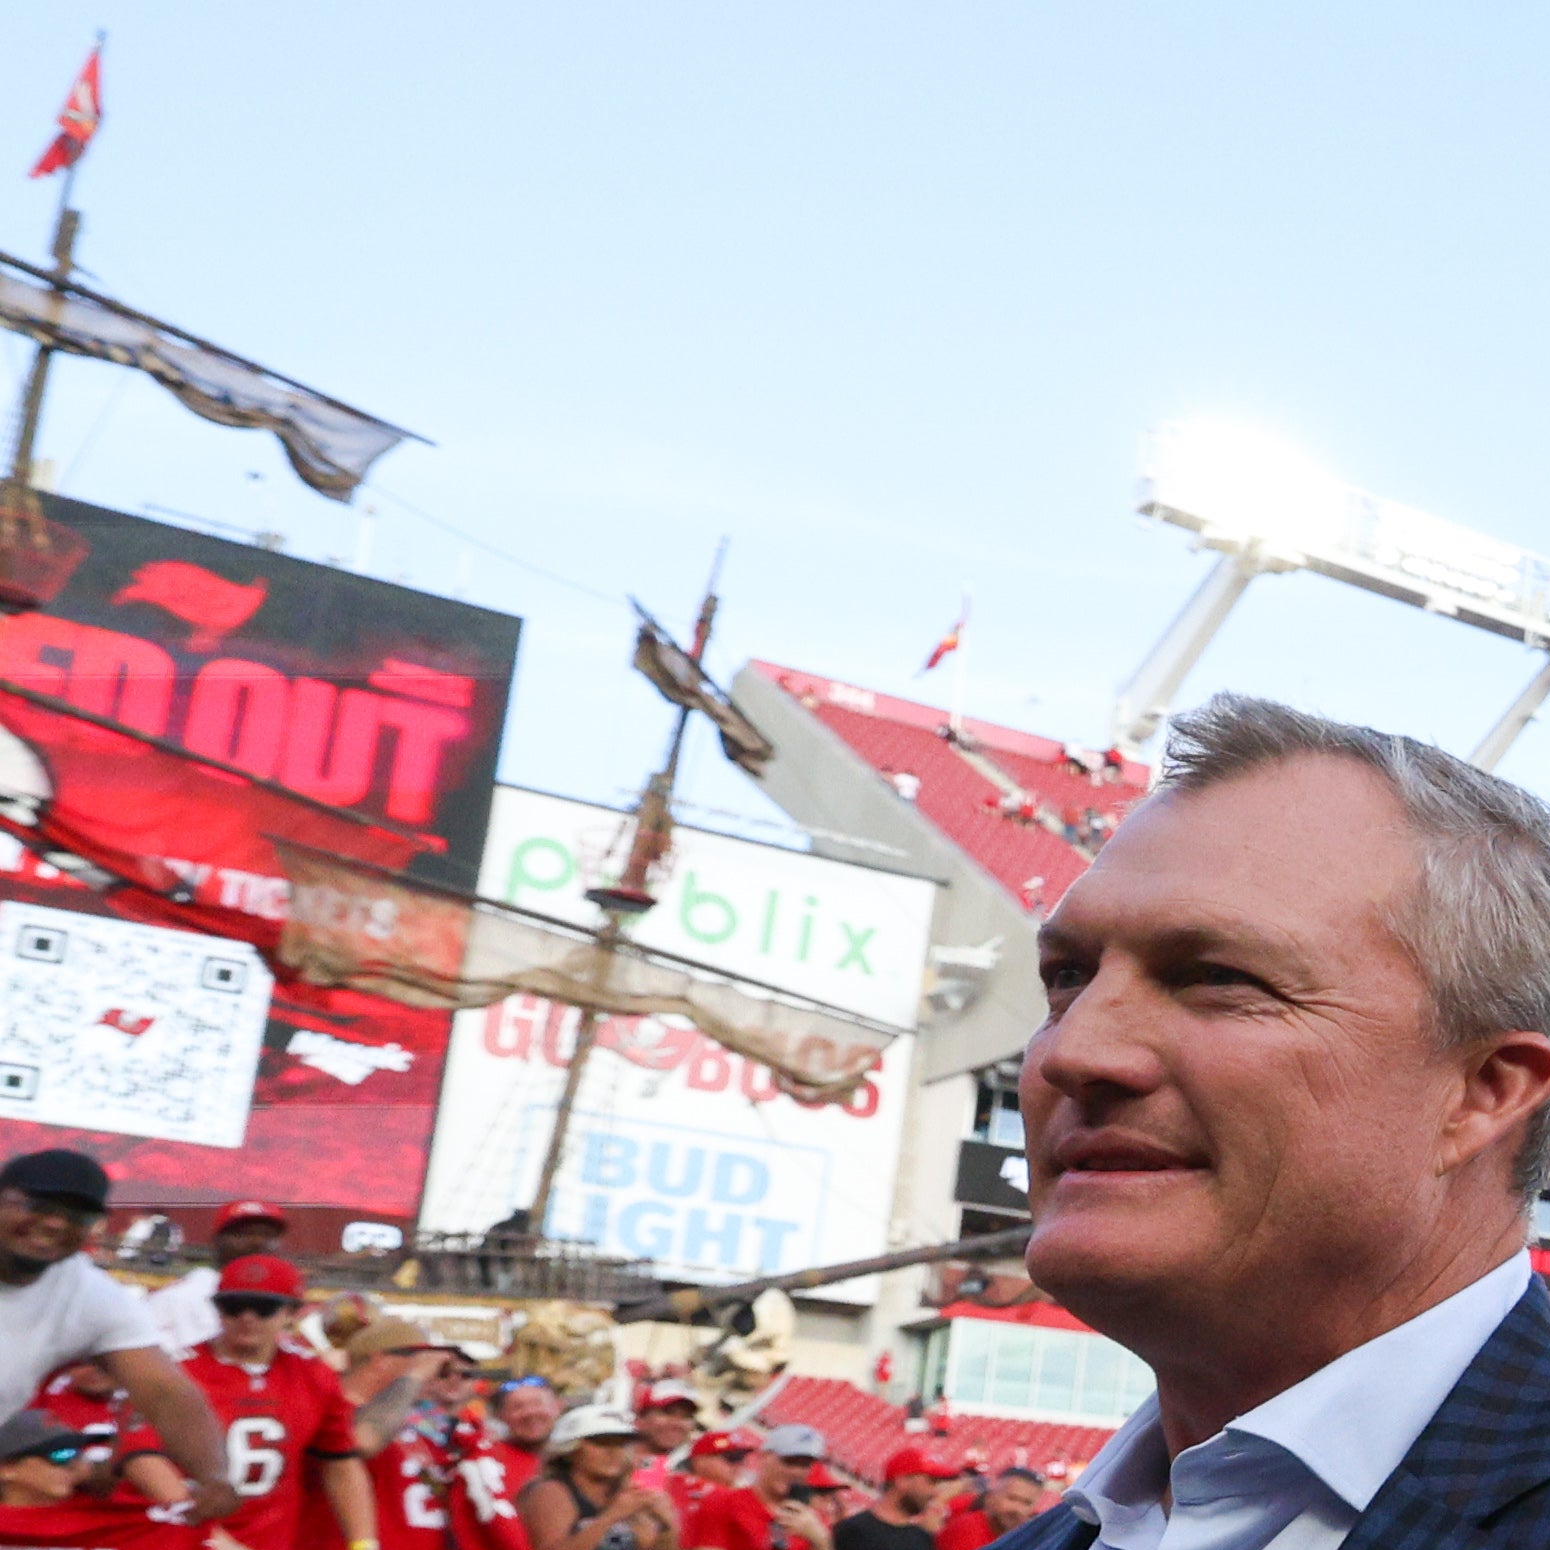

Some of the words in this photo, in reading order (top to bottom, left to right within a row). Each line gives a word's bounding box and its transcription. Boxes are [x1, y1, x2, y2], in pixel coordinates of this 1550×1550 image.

[184, 656, 472, 824] OUT
[505, 836, 876, 976] pblix
[581, 1131, 771, 1207] BUD
[226, 1416, 285, 1497] 6
